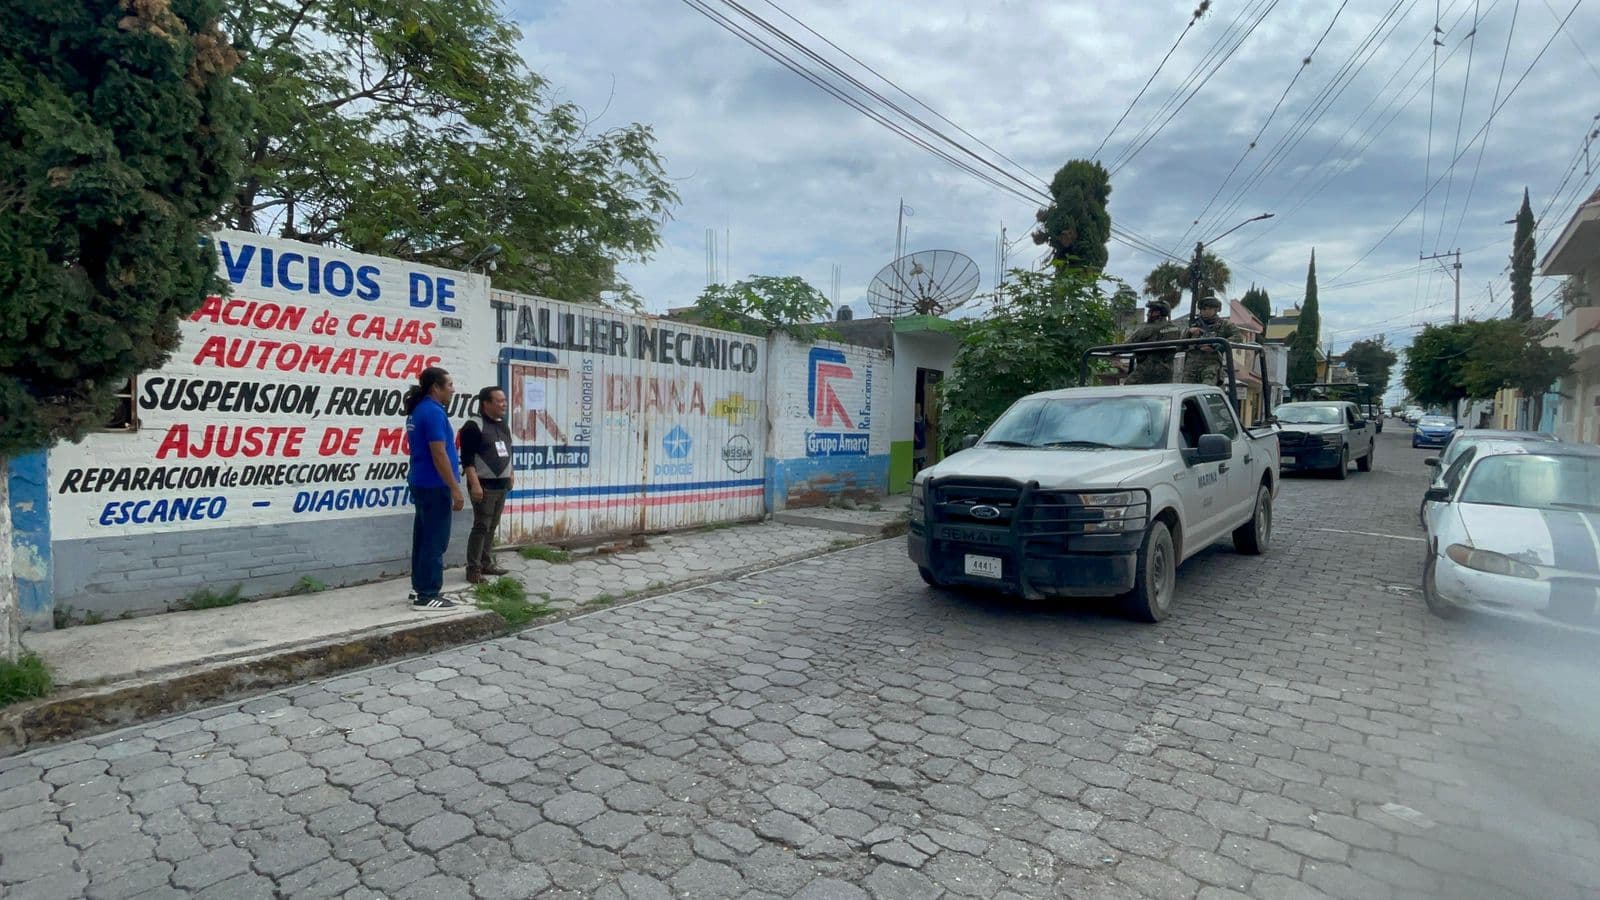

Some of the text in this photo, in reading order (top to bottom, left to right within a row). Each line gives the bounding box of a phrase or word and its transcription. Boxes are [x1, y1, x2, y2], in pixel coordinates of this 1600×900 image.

[219, 240, 456, 312] VICIOS DE
[190, 296, 437, 346] ACION de CAJAS
[490, 299, 758, 374] TALLER MECANICO
[193, 335, 442, 380] AUTOMATICAS
[138, 376, 320, 418] SUSPENSION,
[446, 393, 480, 418] UTO
[606, 373, 707, 416] DIANA
[155, 423, 306, 460] AJUSTE
[318, 426, 364, 457] DE
[512, 446, 588, 470] rupo Amaro
[721, 447, 752, 460] NISSAN
[807, 433, 868, 456] Grupo Amaro
[58, 461, 409, 495] REPARACION de DIRECCIONES HIDR
[655, 463, 694, 476] DODGE
[100, 495, 227, 526] ESCANEO
[292, 485, 416, 514] DIAGNOSTI
